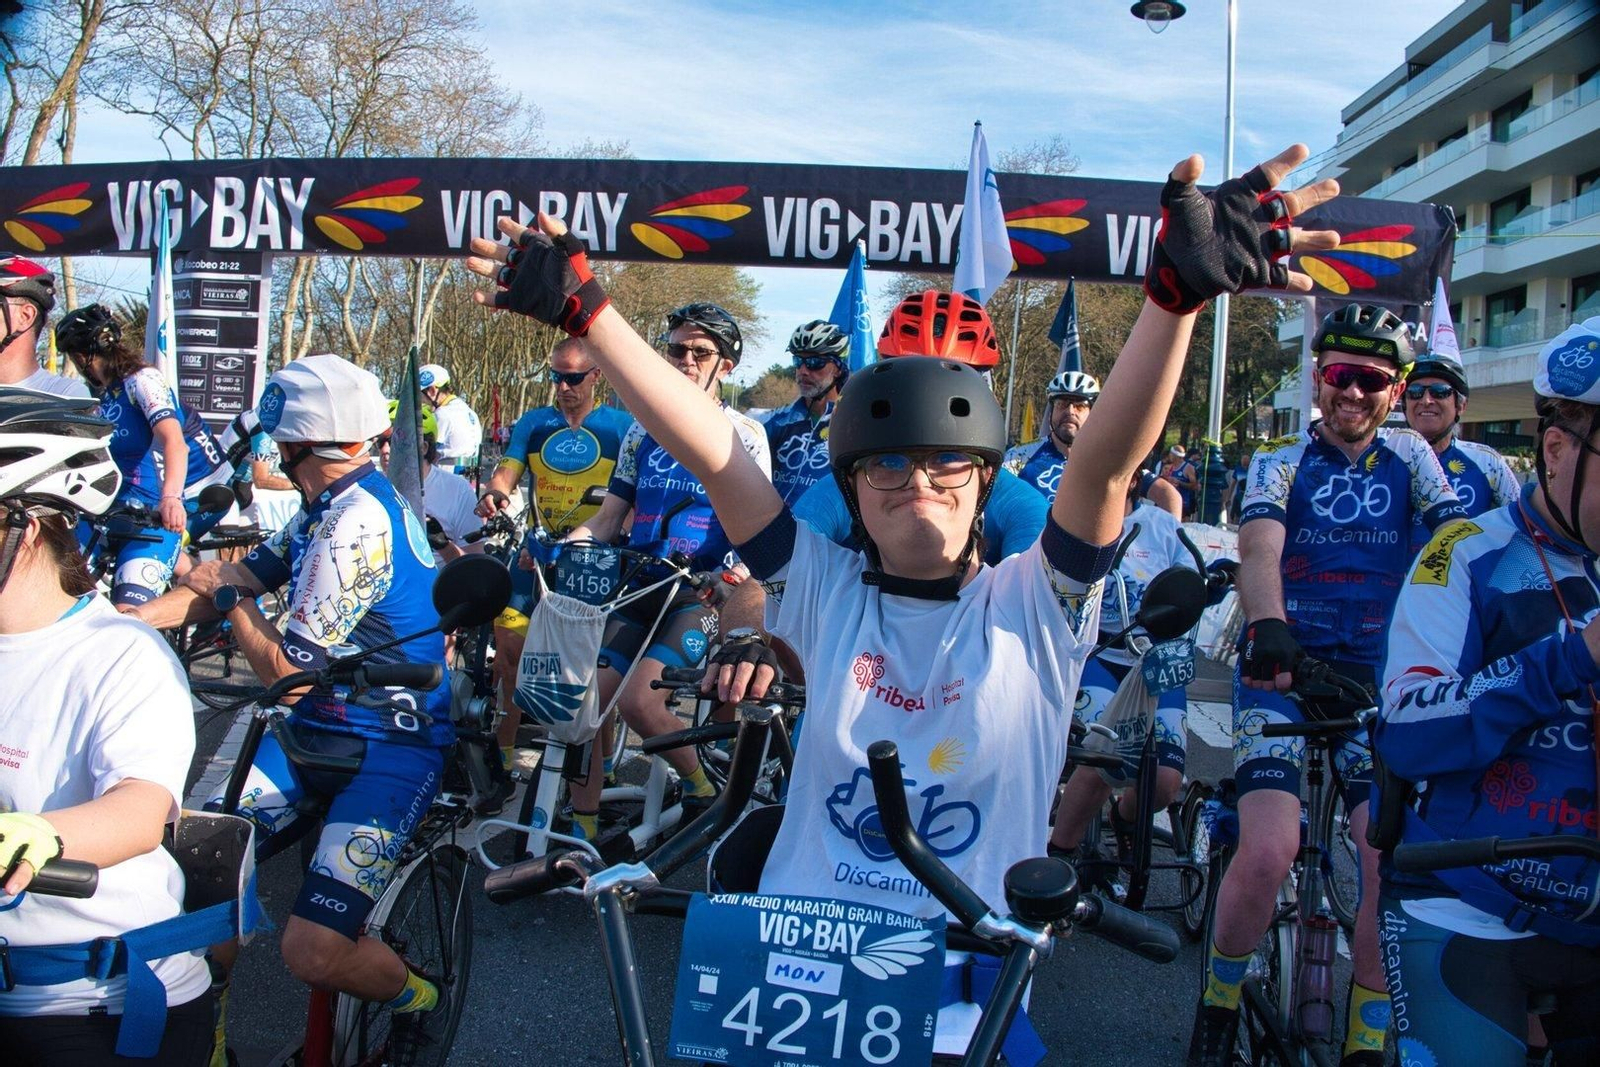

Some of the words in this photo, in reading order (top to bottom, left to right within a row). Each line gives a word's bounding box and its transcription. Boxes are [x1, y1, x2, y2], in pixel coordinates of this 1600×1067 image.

[209, 177, 316, 250] BAY
[763, 197, 841, 260] VIG
[869, 200, 964, 264] BAY
[1106, 213, 1161, 277] VI
[176, 328, 218, 337] POWERADE
[180, 378, 204, 387] MRW
[1295, 527, 1399, 545] DisCamino
[124, 590, 148, 602] ZICO
[566, 572, 611, 596] 4158
[1521, 580, 1553, 591] ZICO
[1158, 661, 1193, 686] 4153
[1166, 752, 1185, 763] ZICO
[1252, 769, 1285, 779] ZICO
[384, 770, 436, 863] DisCamino
[1508, 872, 1590, 900] GALICIA
[309, 892, 348, 913] ZICO
[709, 893, 740, 905] XXIII
[741, 896, 781, 911] MEDIO
[783, 899, 845, 920] MARATÓN
[848, 905, 882, 925] GRAN
[885, 910, 923, 931] BAHÍA
[759, 911, 801, 947] VIG
[812, 918, 866, 956] BAY
[690, 963, 721, 975] 14/04/24
[774, 963, 825, 984] MON
[1384, 910, 1411, 1032] discamino
[721, 986, 902, 1065] 4218
[923, 1013, 934, 1038] 4218
[675, 1045, 719, 1059] VIEIRASA
